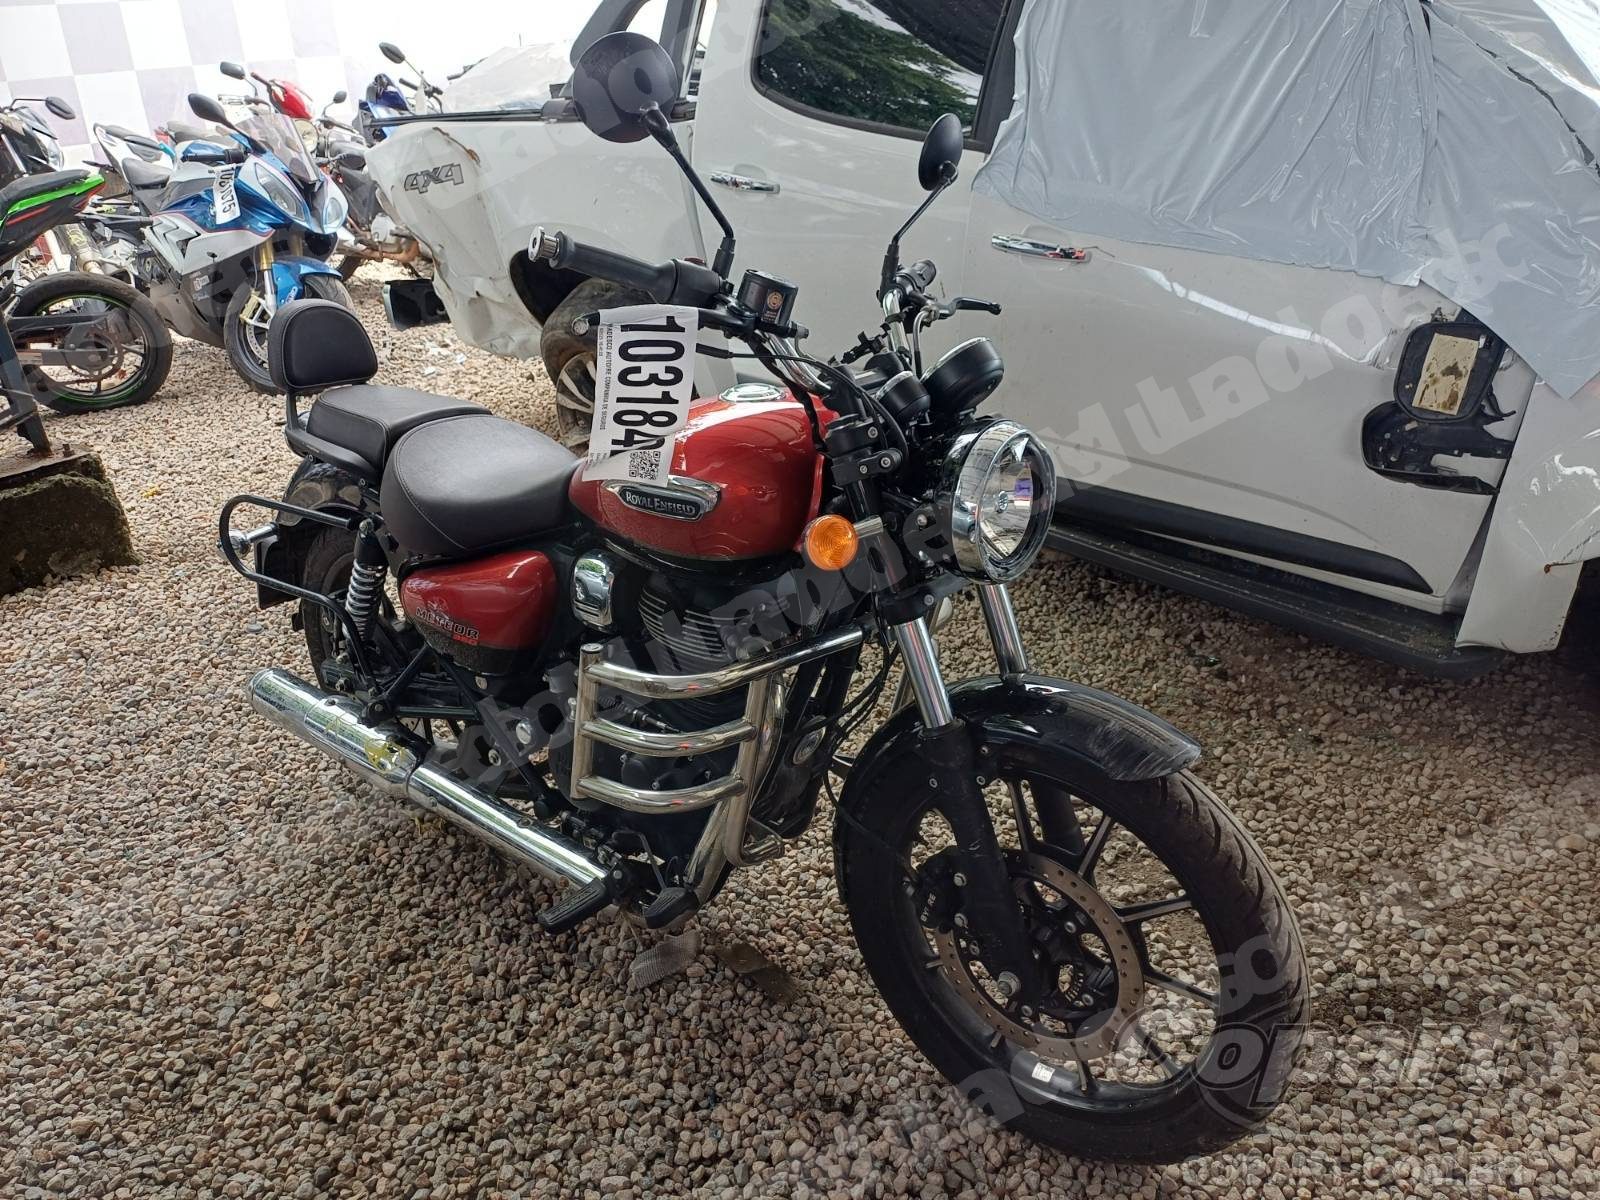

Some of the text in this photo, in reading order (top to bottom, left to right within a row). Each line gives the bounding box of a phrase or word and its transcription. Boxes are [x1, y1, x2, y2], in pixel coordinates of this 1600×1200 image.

[625, 491, 696, 515] ROYAL ENFIELD
[416, 607, 480, 640] METEOR
